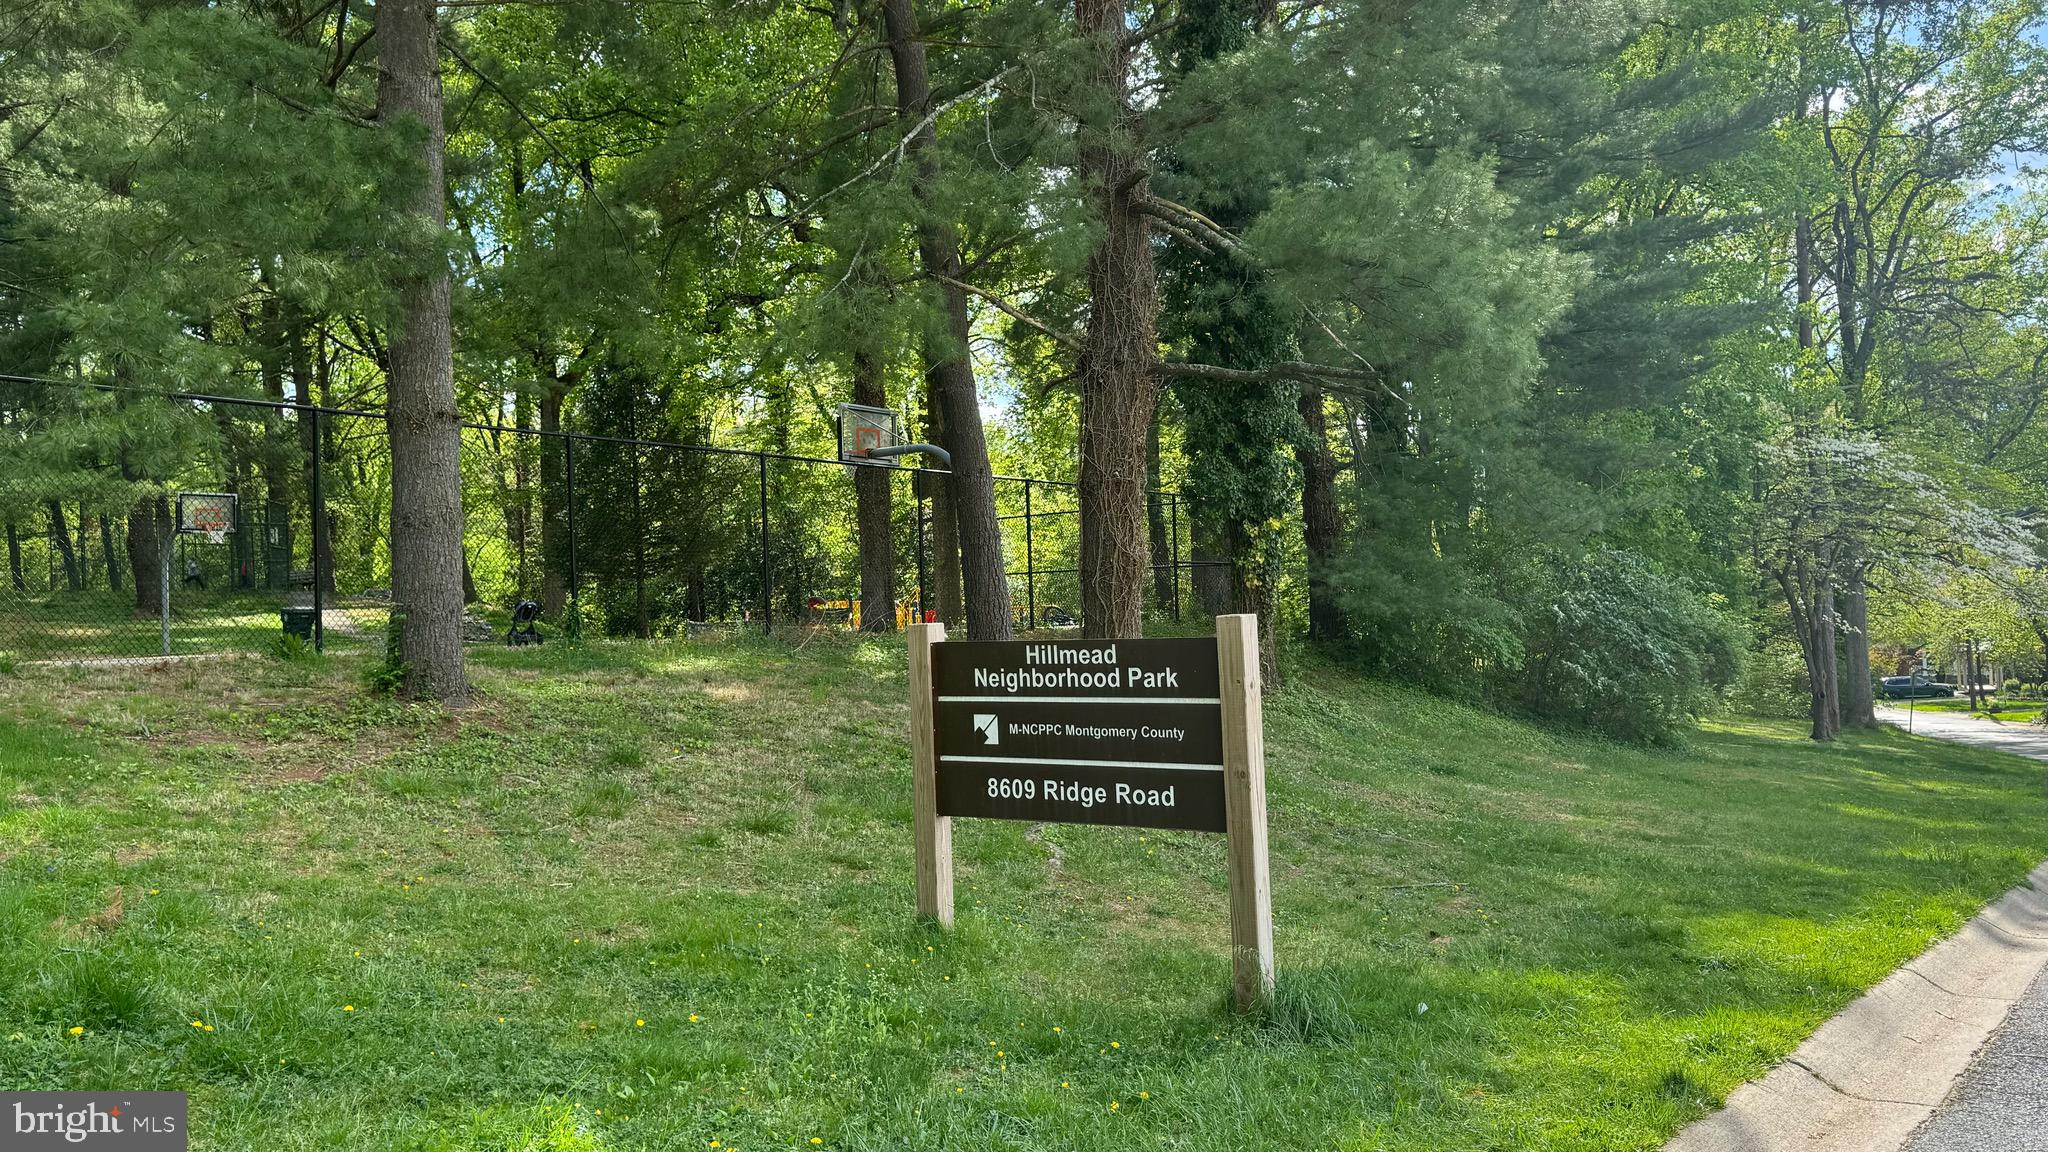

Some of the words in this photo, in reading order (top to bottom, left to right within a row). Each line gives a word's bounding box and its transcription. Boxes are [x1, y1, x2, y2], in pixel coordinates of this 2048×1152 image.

[1026, 643, 1117, 665] Hillmead
[974, 667, 1121, 693] Neighborhood
[1127, 666, 1179, 688] Park
[1009, 723, 1062, 736] M-NCPPC
[1065, 724, 1138, 741] Montgomery
[1140, 725, 1185, 742] County
[987, 777, 1036, 800] 8609
[1043, 779, 1107, 808] Ridge
[1115, 782, 1175, 807] Road
